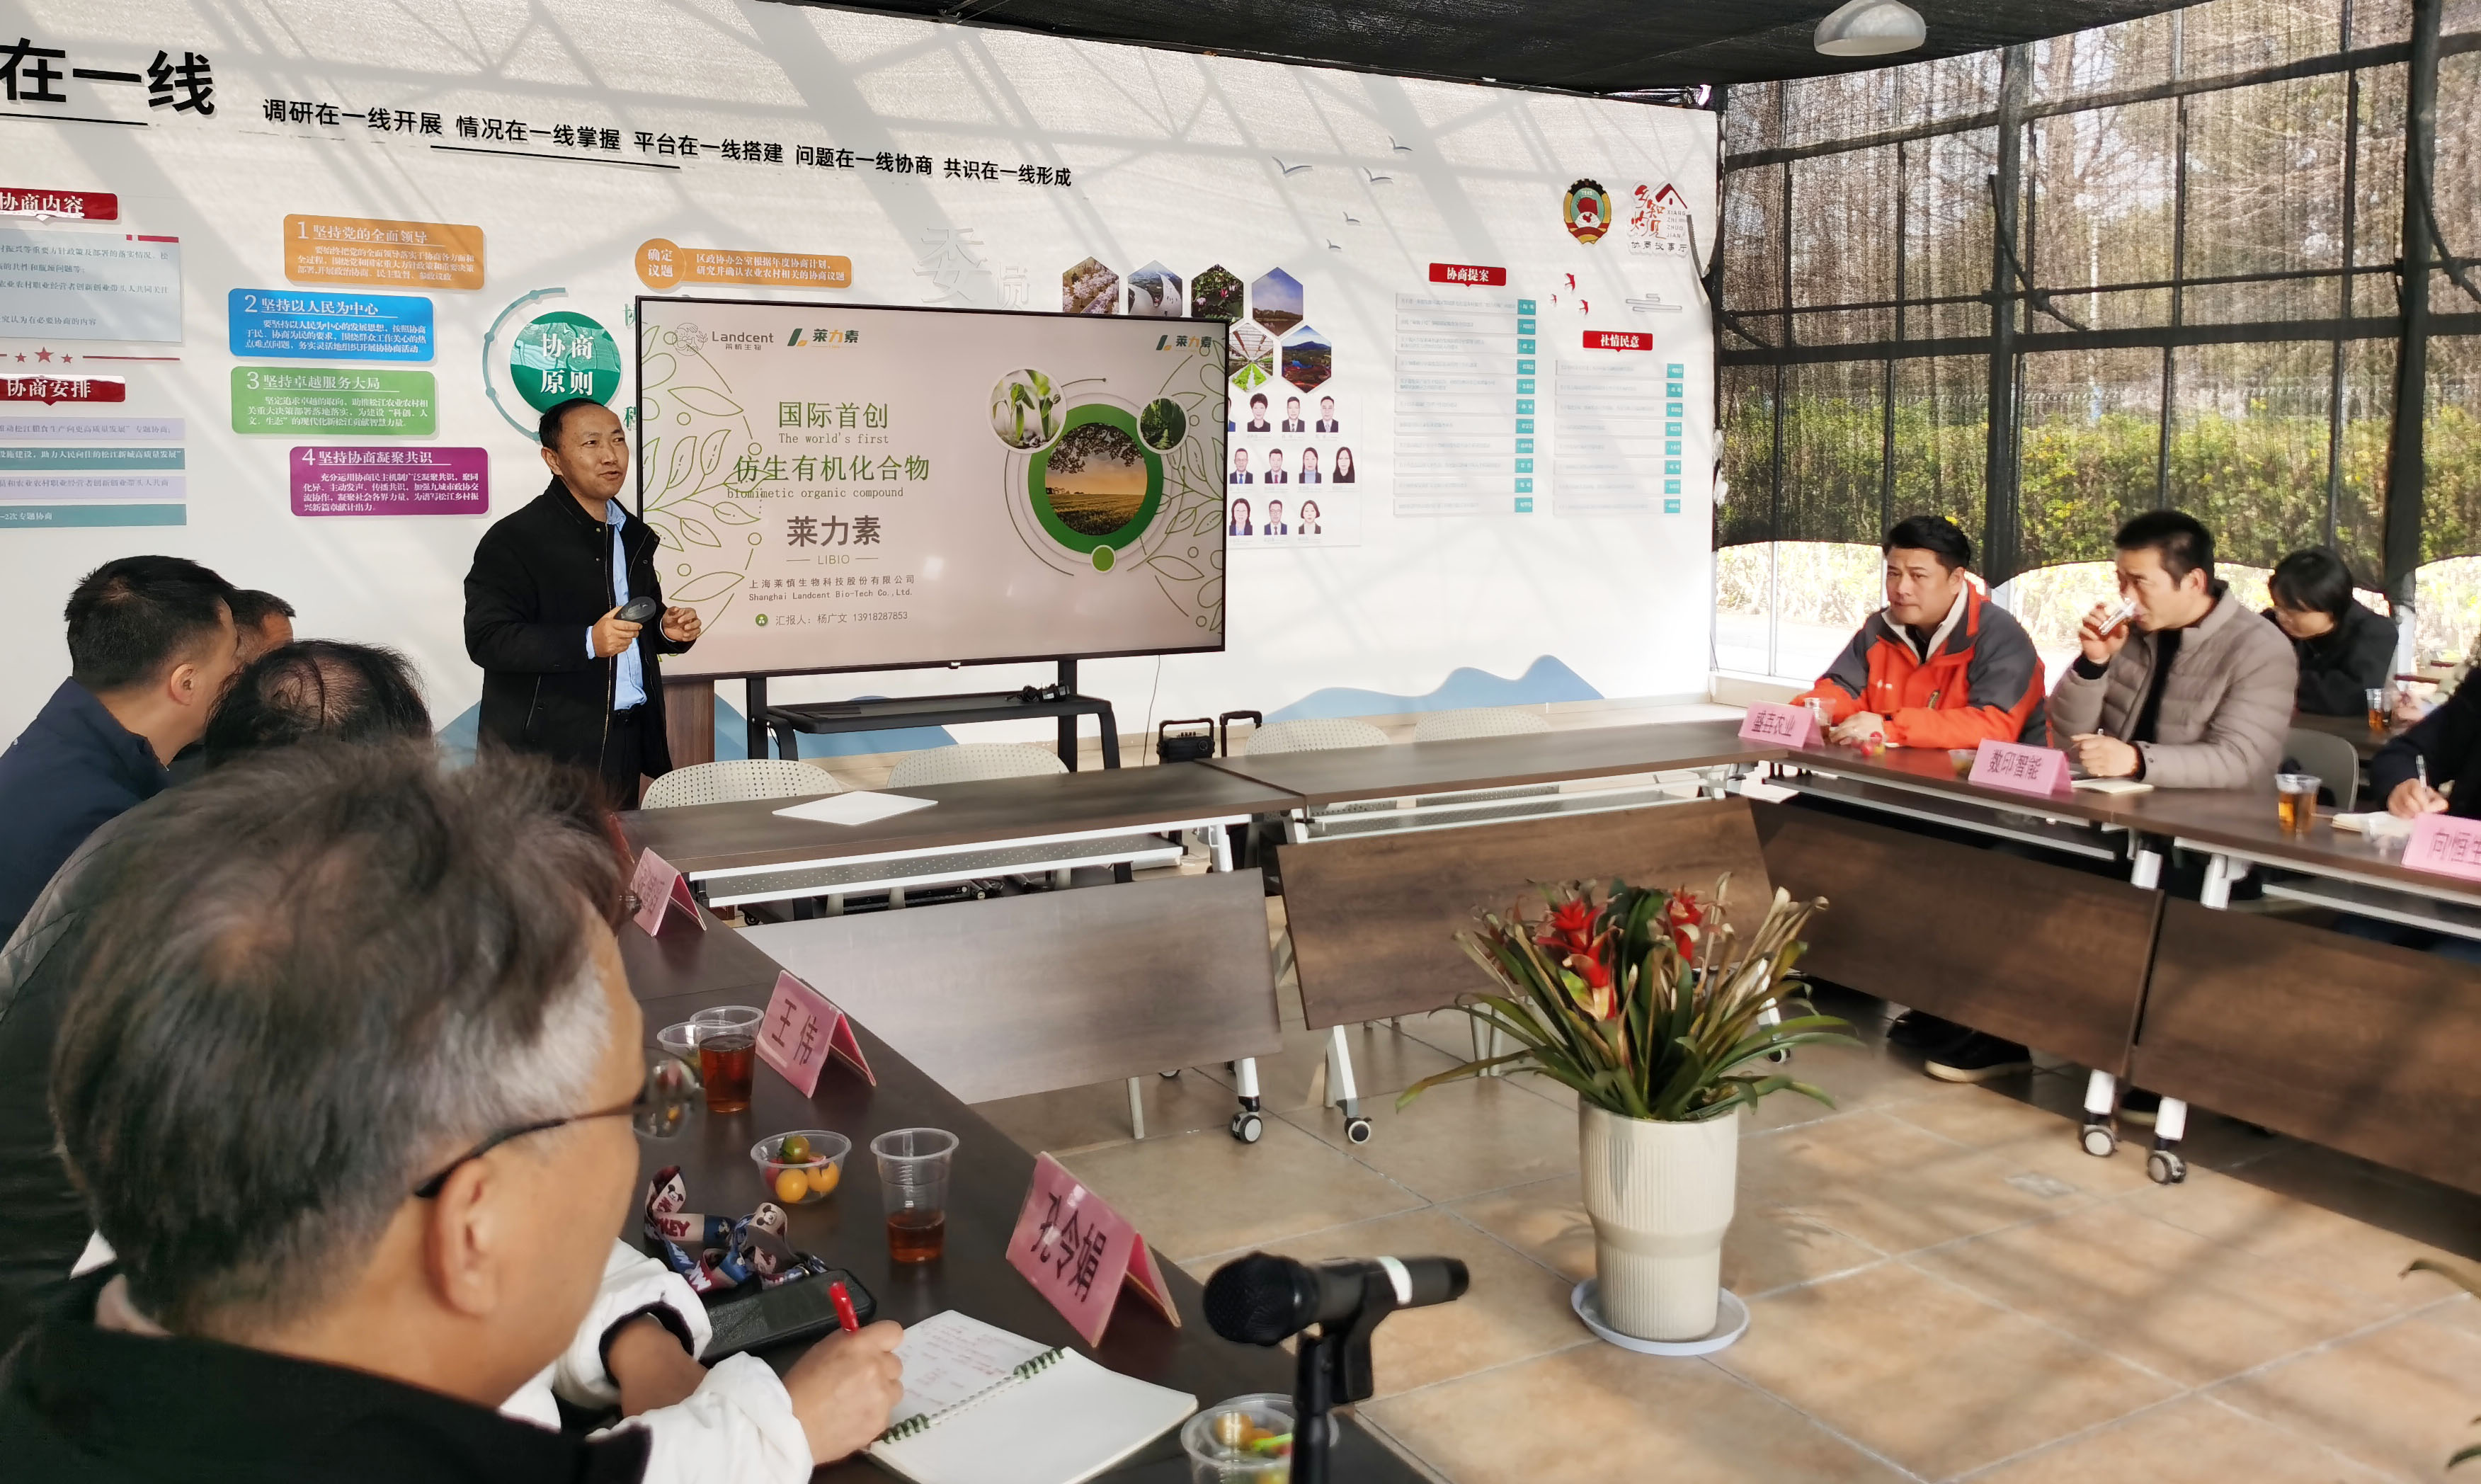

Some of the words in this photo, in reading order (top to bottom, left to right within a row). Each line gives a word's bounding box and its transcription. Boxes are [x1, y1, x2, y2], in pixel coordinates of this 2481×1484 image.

[0, 37, 215, 115] 在一线
[263, 99, 443, 136] 调研在一线开展
[456, 115, 620, 150] 情况在一线掌握
[634, 131, 783, 163] 平台在一线搭建
[795, 145, 932, 175] 问题在一线协商
[944, 159, 1071, 186] 共识在一线形成
[0, 192, 84, 213] 协商内容
[297, 221, 309, 239] 1
[313, 224, 428, 244] 坚持党的全面领导
[1631, 241, 1687, 252] 协商议事厅
[647, 248, 673, 263] 确定
[647, 264, 673, 278] 议题
[1447, 267, 1489, 282] 协商提案
[244, 295, 258, 313] 2
[261, 298, 379, 315] 坚持以人民为中心
[712, 331, 774, 343] Landcent
[811, 328, 860, 343] 莱力素
[1175, 336, 1211, 348] 莱力素
[1600, 333, 1640, 348] 社情民意
[541, 333, 594, 360] 协商
[247, 371, 259, 389] 3
[263, 375, 380, 389] 坚持卓越服务大局
[540, 369, 594, 396] 原则
[7, 379, 91, 398] 协商安排
[779, 401, 888, 428] 国际首创
[779, 433, 798, 443] The
[806, 433, 850, 443] world's
[857, 433, 889, 443] first
[302, 449, 316, 466] 4
[319, 451, 433, 464] 坚持协商凝聚共识
[733, 455, 929, 481] 仿生有机化合物
[727, 488, 794, 498] biomimetic
[802, 488, 845, 499] organic
[853, 487, 903, 498] compound
[787, 515, 881, 547] 莱力素
[818, 555, 850, 564] LIBIO
[749, 575, 915, 589] 上海莱慎生物科技股份有限公司
[748, 592, 787, 602] Shanghai
[792, 591, 830, 600] Landcent
[835, 590, 873, 598] Bio-Tech
[776, 615, 811, 626] 汇报人：
[818, 613, 848, 624] 杨广文
[853, 612, 908, 622] 13918287853
[1987, 750, 2041, 780] 数印智能
